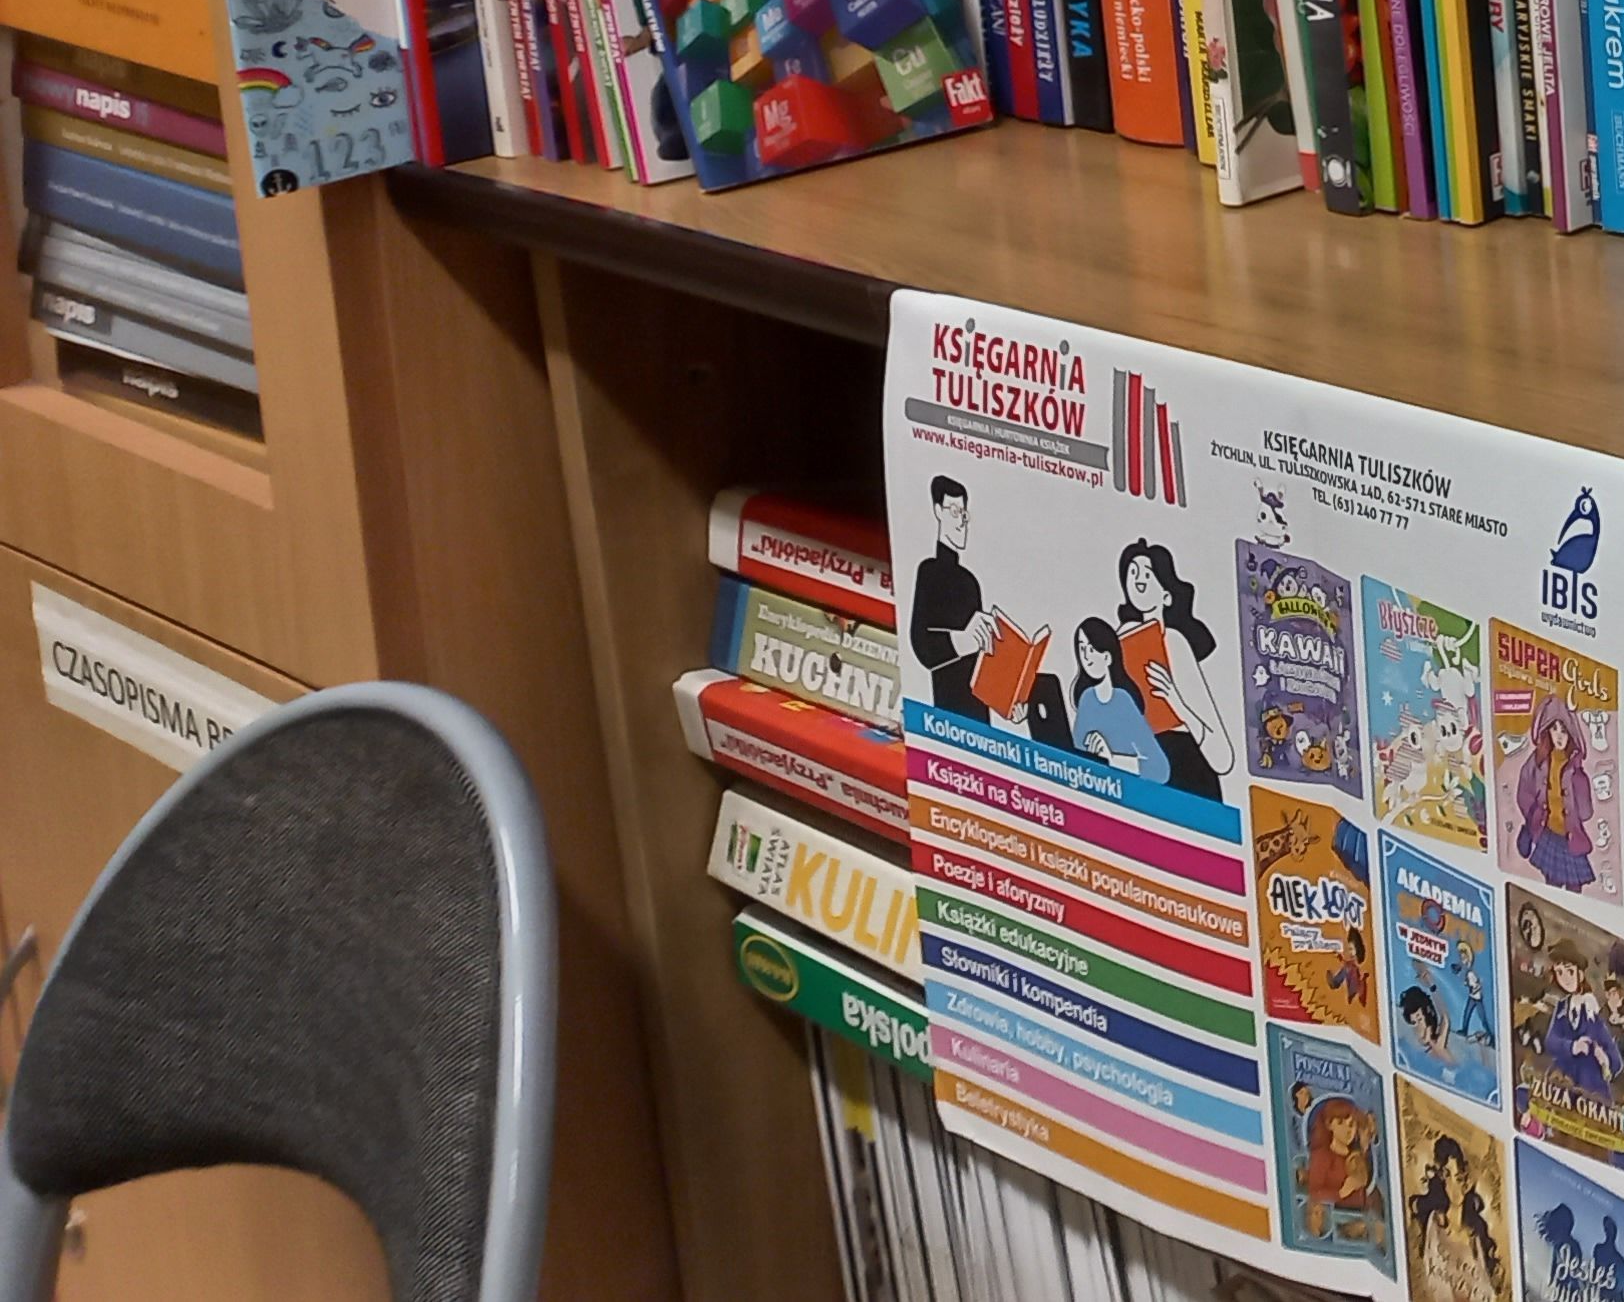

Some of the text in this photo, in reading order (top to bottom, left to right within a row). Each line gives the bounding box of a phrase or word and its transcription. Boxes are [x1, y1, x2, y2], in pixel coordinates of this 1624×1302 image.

[75, 86, 132, 119] napis
[944, 73, 984, 107] Fakt
[932, 367, 1088, 439] TULISZKÓW
[911, 425, 1105, 488] www.ksiegarnia-tuliszkow.pl
[1263, 429, 1452, 500] KSIĘGARNIA TULISZKÓW
[52, 640, 203, 749] CZASOPISMA
[922, 712, 1124, 800] Kolorowanki łamigłówki
[926, 760, 1065, 828] Książki Święta
[930, 807, 1028, 858] Encyklopedie
[932, 853, 1065, 925] Poezje aforyzmy
[936, 900, 1090, 978] Książki edukacyjne
[940, 945, 1109, 1034] Słowniki kompendia
